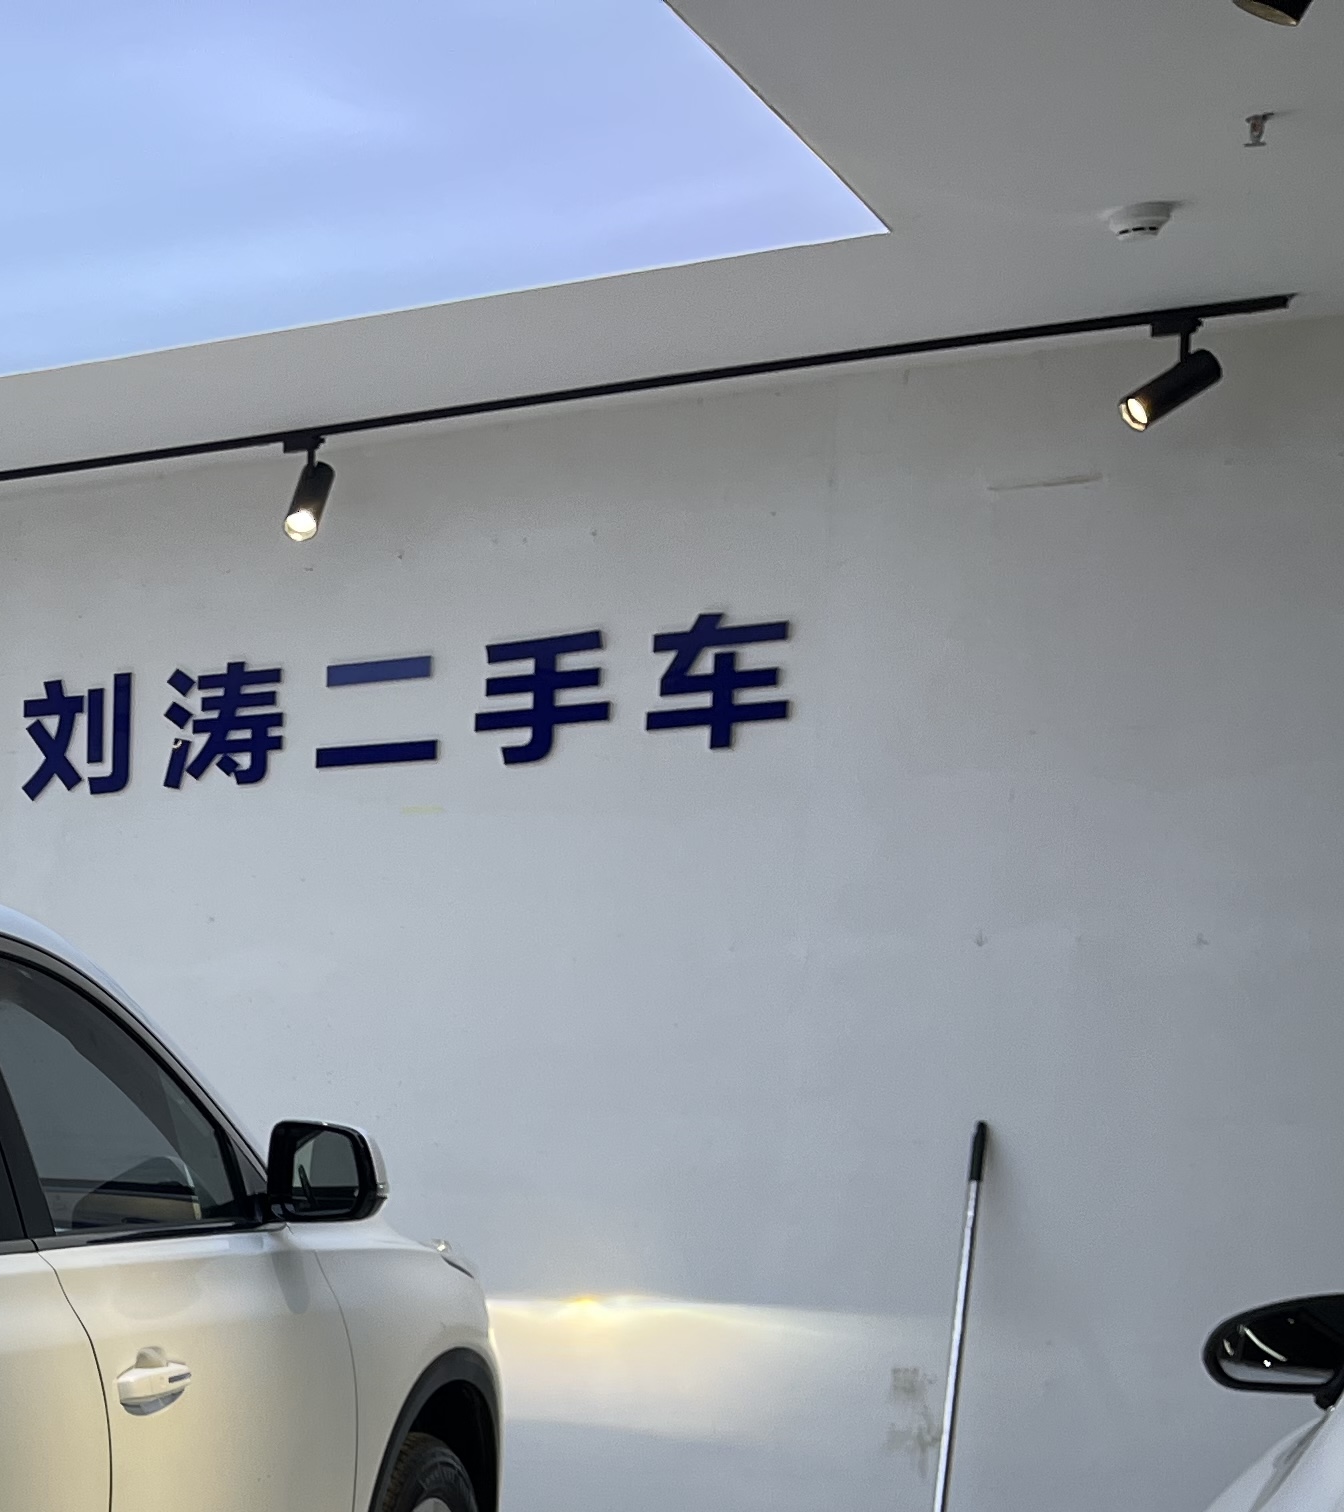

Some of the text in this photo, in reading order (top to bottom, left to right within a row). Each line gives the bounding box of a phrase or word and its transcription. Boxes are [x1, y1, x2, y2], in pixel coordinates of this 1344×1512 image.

[22, 612, 790, 802] 刘涛二手车
